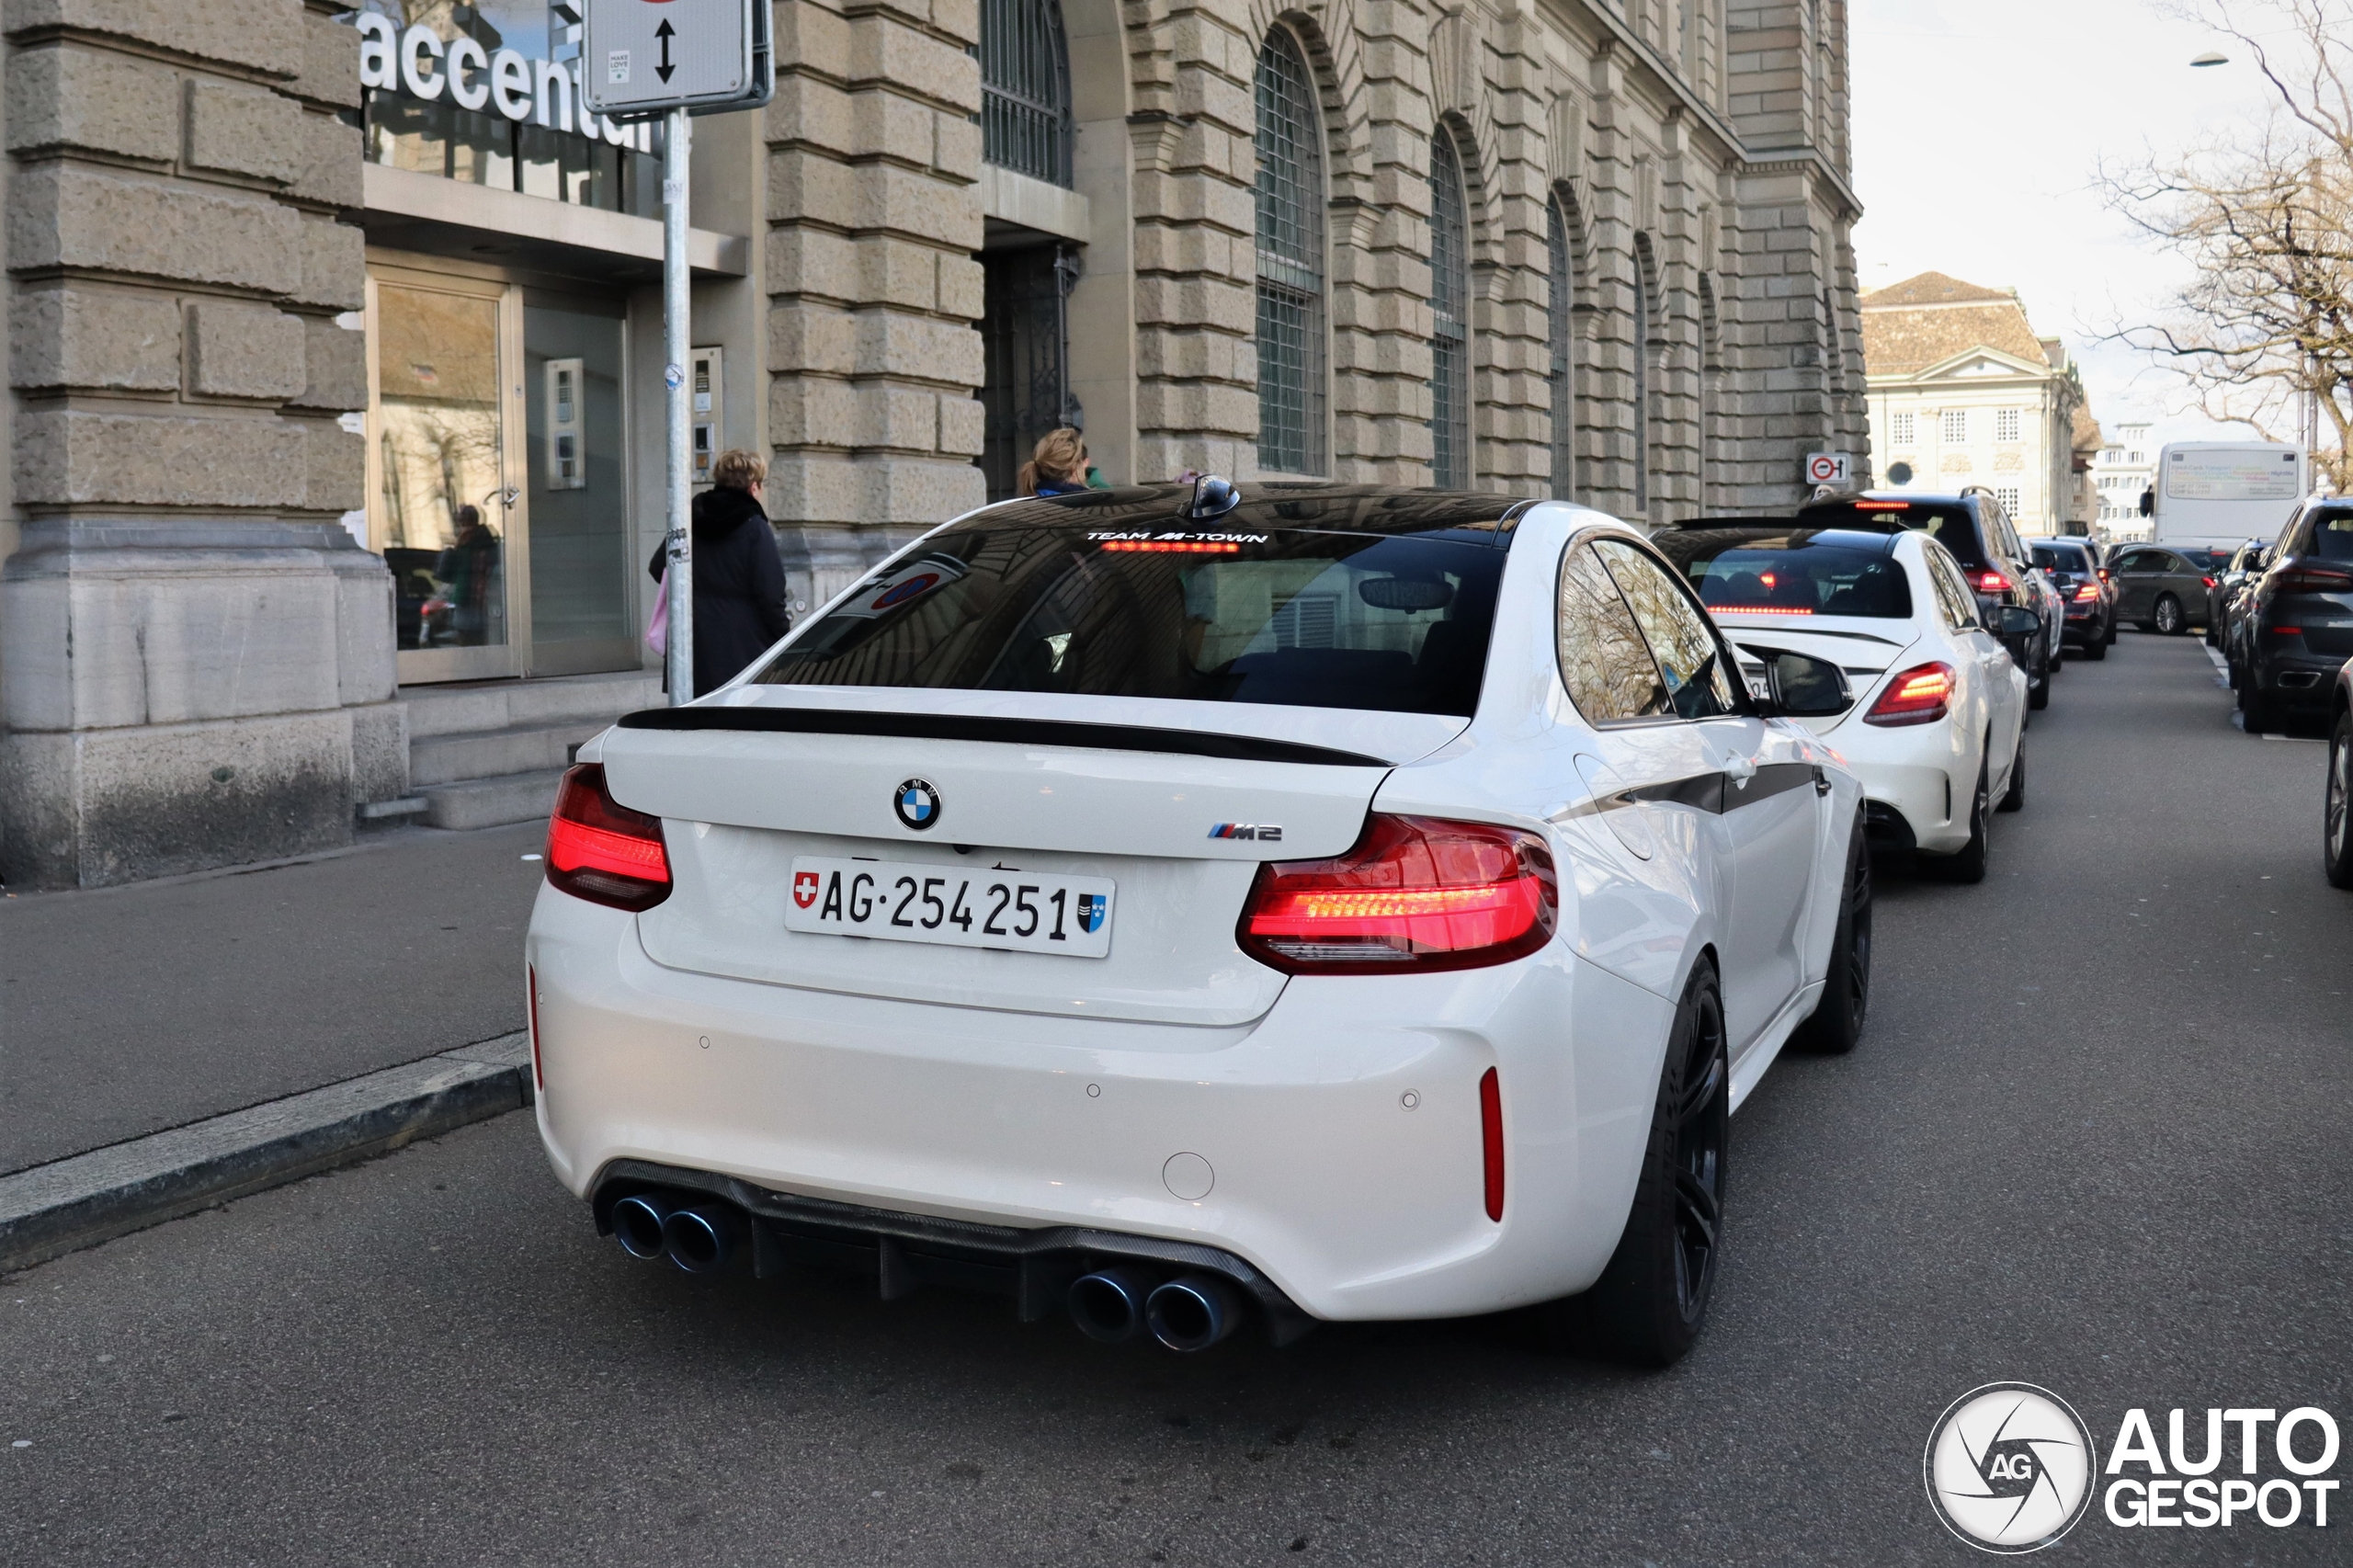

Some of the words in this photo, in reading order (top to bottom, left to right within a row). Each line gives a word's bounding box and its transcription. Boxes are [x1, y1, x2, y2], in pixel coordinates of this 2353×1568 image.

[1086, 531, 1151, 540] TEAM
[1153, 532, 1268, 543] M-TOWN
[898, 779, 938, 798] BMW
[1226, 824, 1282, 841] M2
